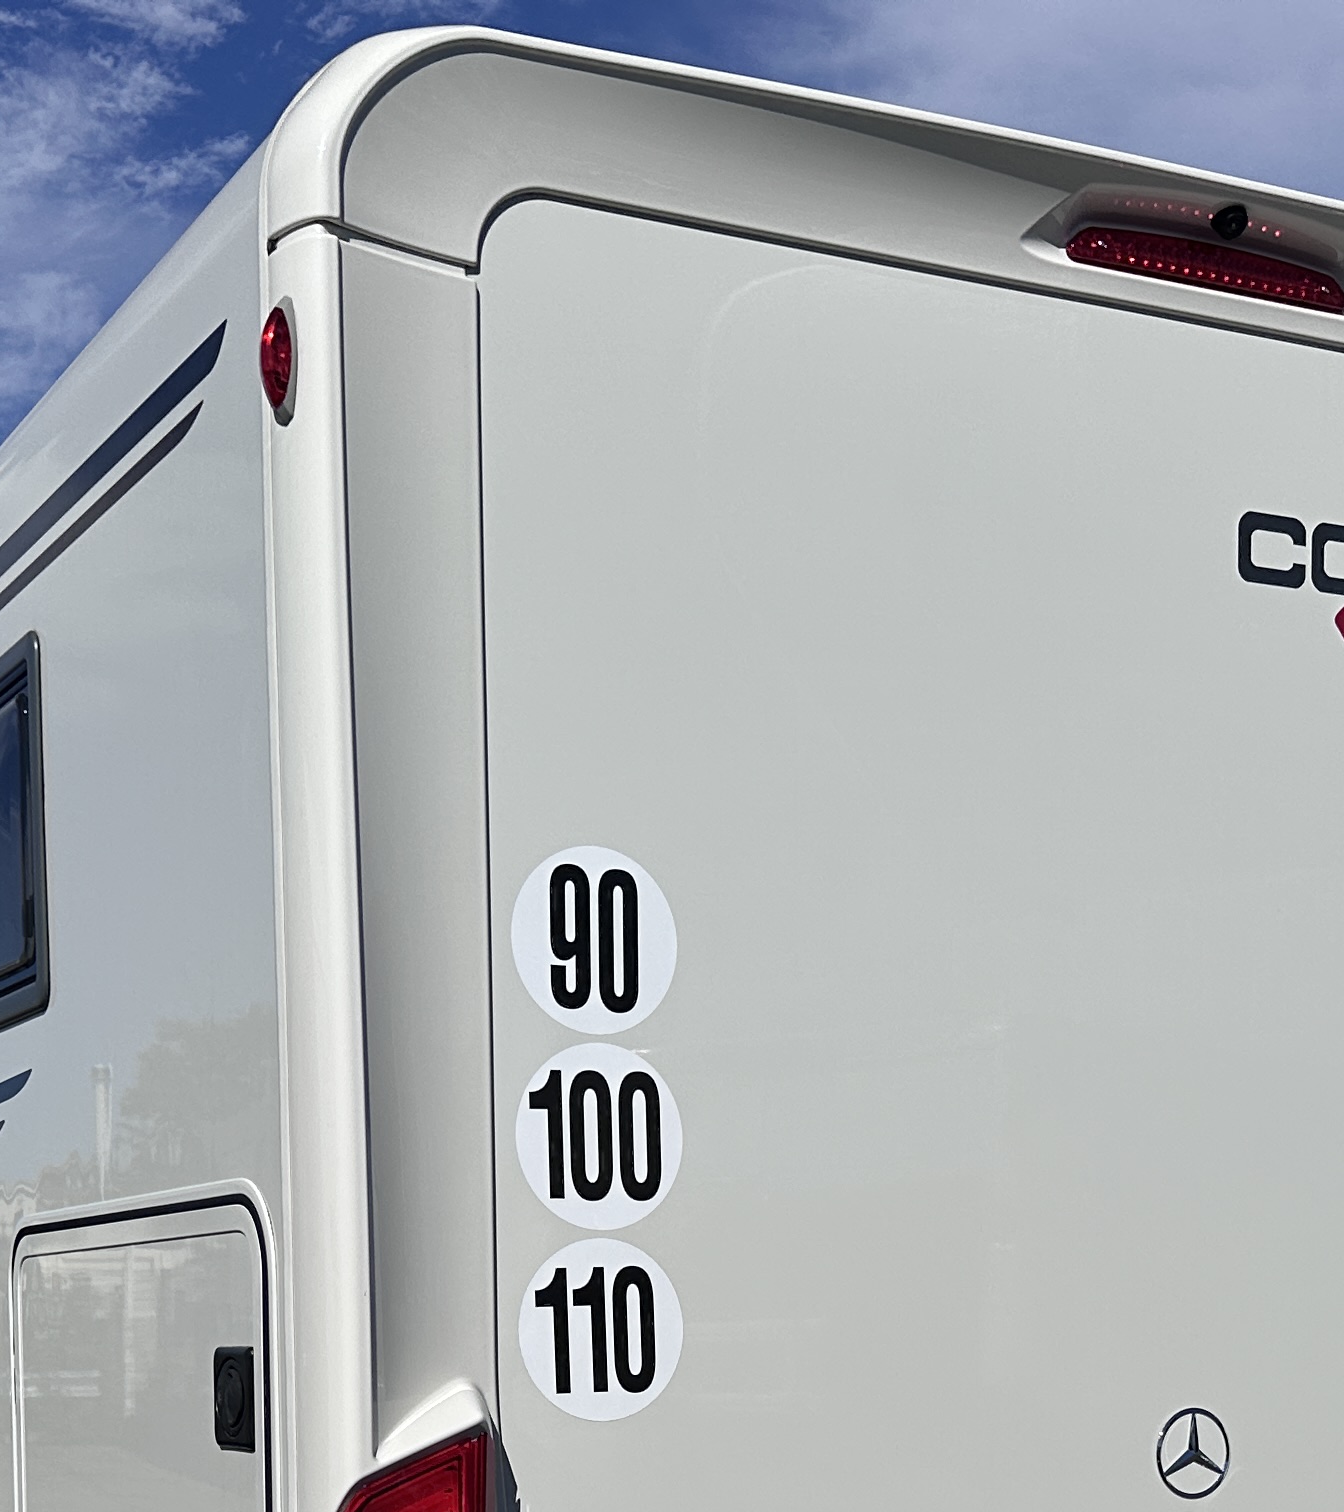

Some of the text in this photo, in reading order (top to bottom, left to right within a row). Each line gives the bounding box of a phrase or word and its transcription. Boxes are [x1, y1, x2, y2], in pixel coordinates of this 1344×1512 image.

[549, 863, 639, 1013] 90
[528, 1069, 662, 1201] 100
[534, 1265, 656, 1393] 110
